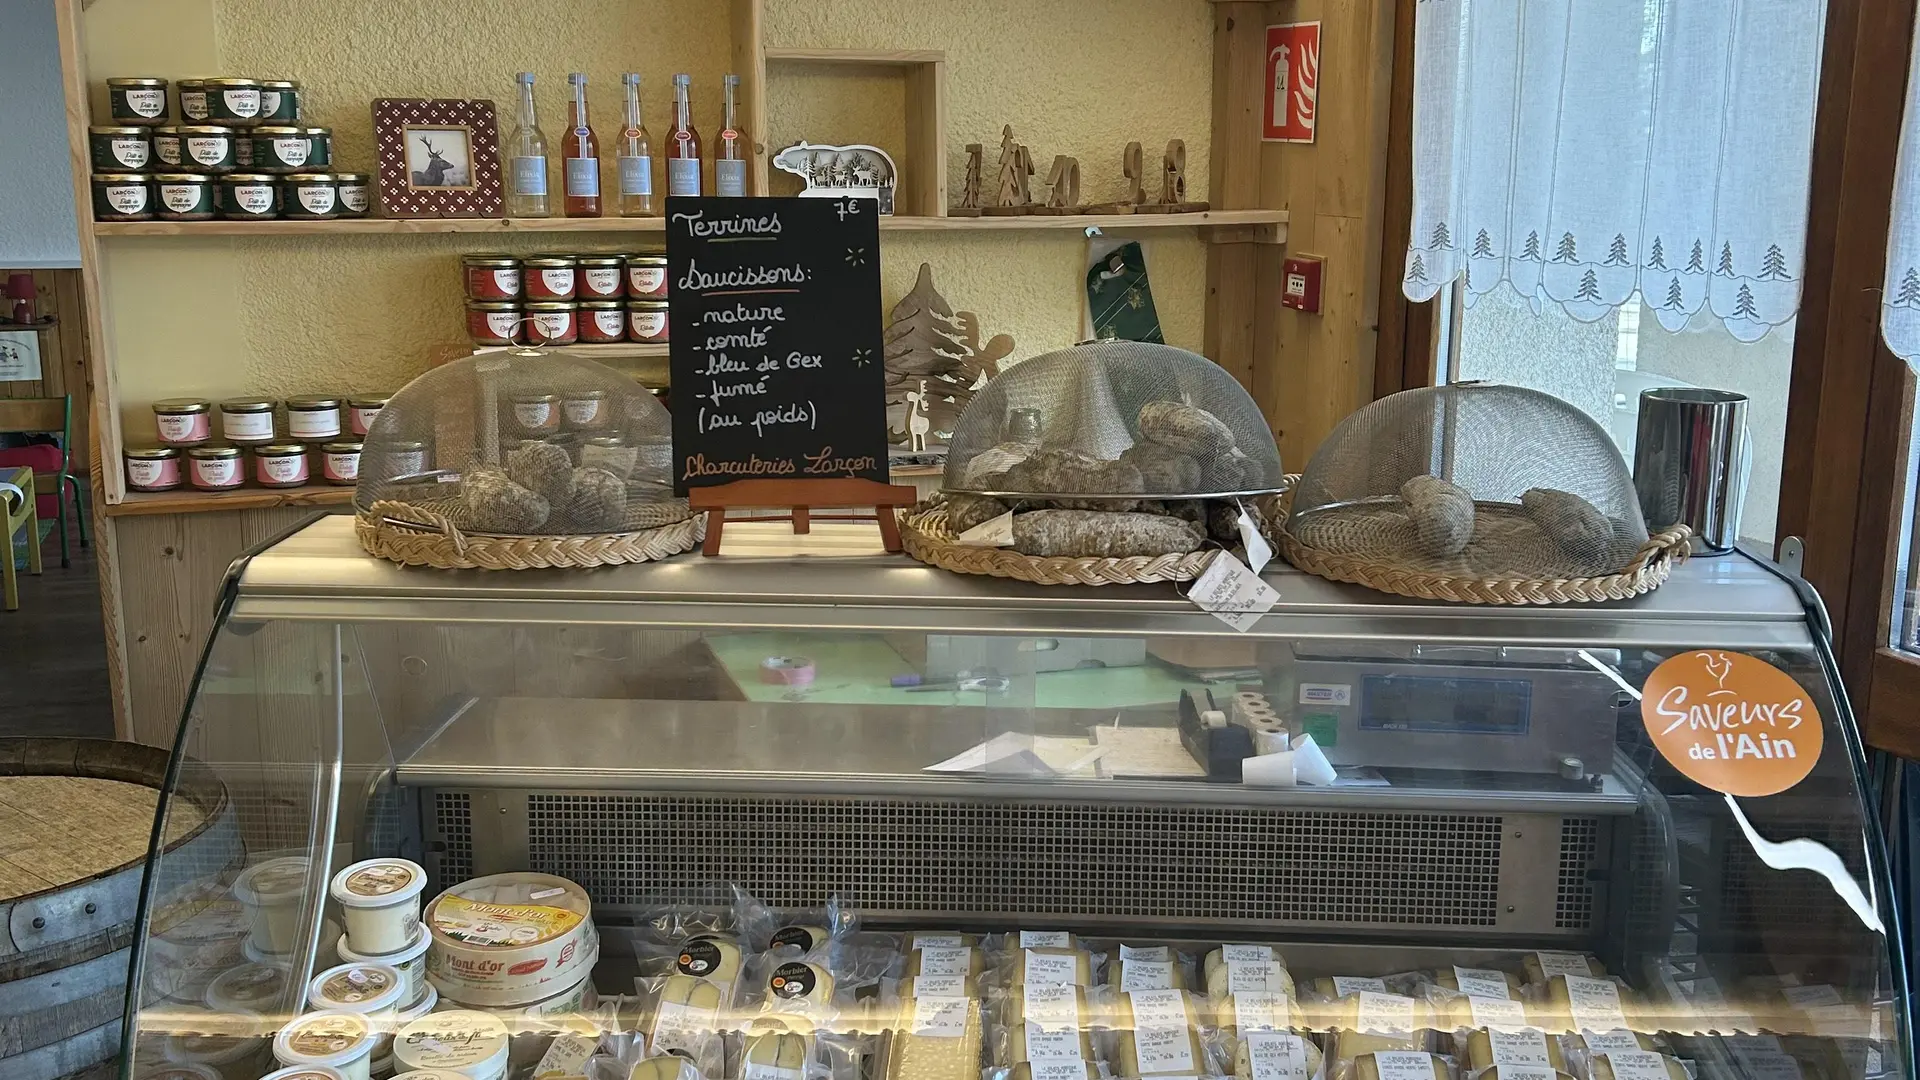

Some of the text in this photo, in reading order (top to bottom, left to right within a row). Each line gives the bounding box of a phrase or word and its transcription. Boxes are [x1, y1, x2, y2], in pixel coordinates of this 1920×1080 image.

[672, 199, 861, 237] Terrines 7€
[678, 258, 813, 290] Saucissons:
[756, 355, 781, 372] de
[786, 351, 824, 370] Gex
[698, 399, 818, 438] (au poids)
[682, 446, 878, 481] Charcuteries Larçon
[1656, 686, 1803, 736] Saveurs
[1688, 732, 1797, 760] de l'Ain
[477, 959, 506, 972] d'or
[776, 966, 809, 977] Morbier
